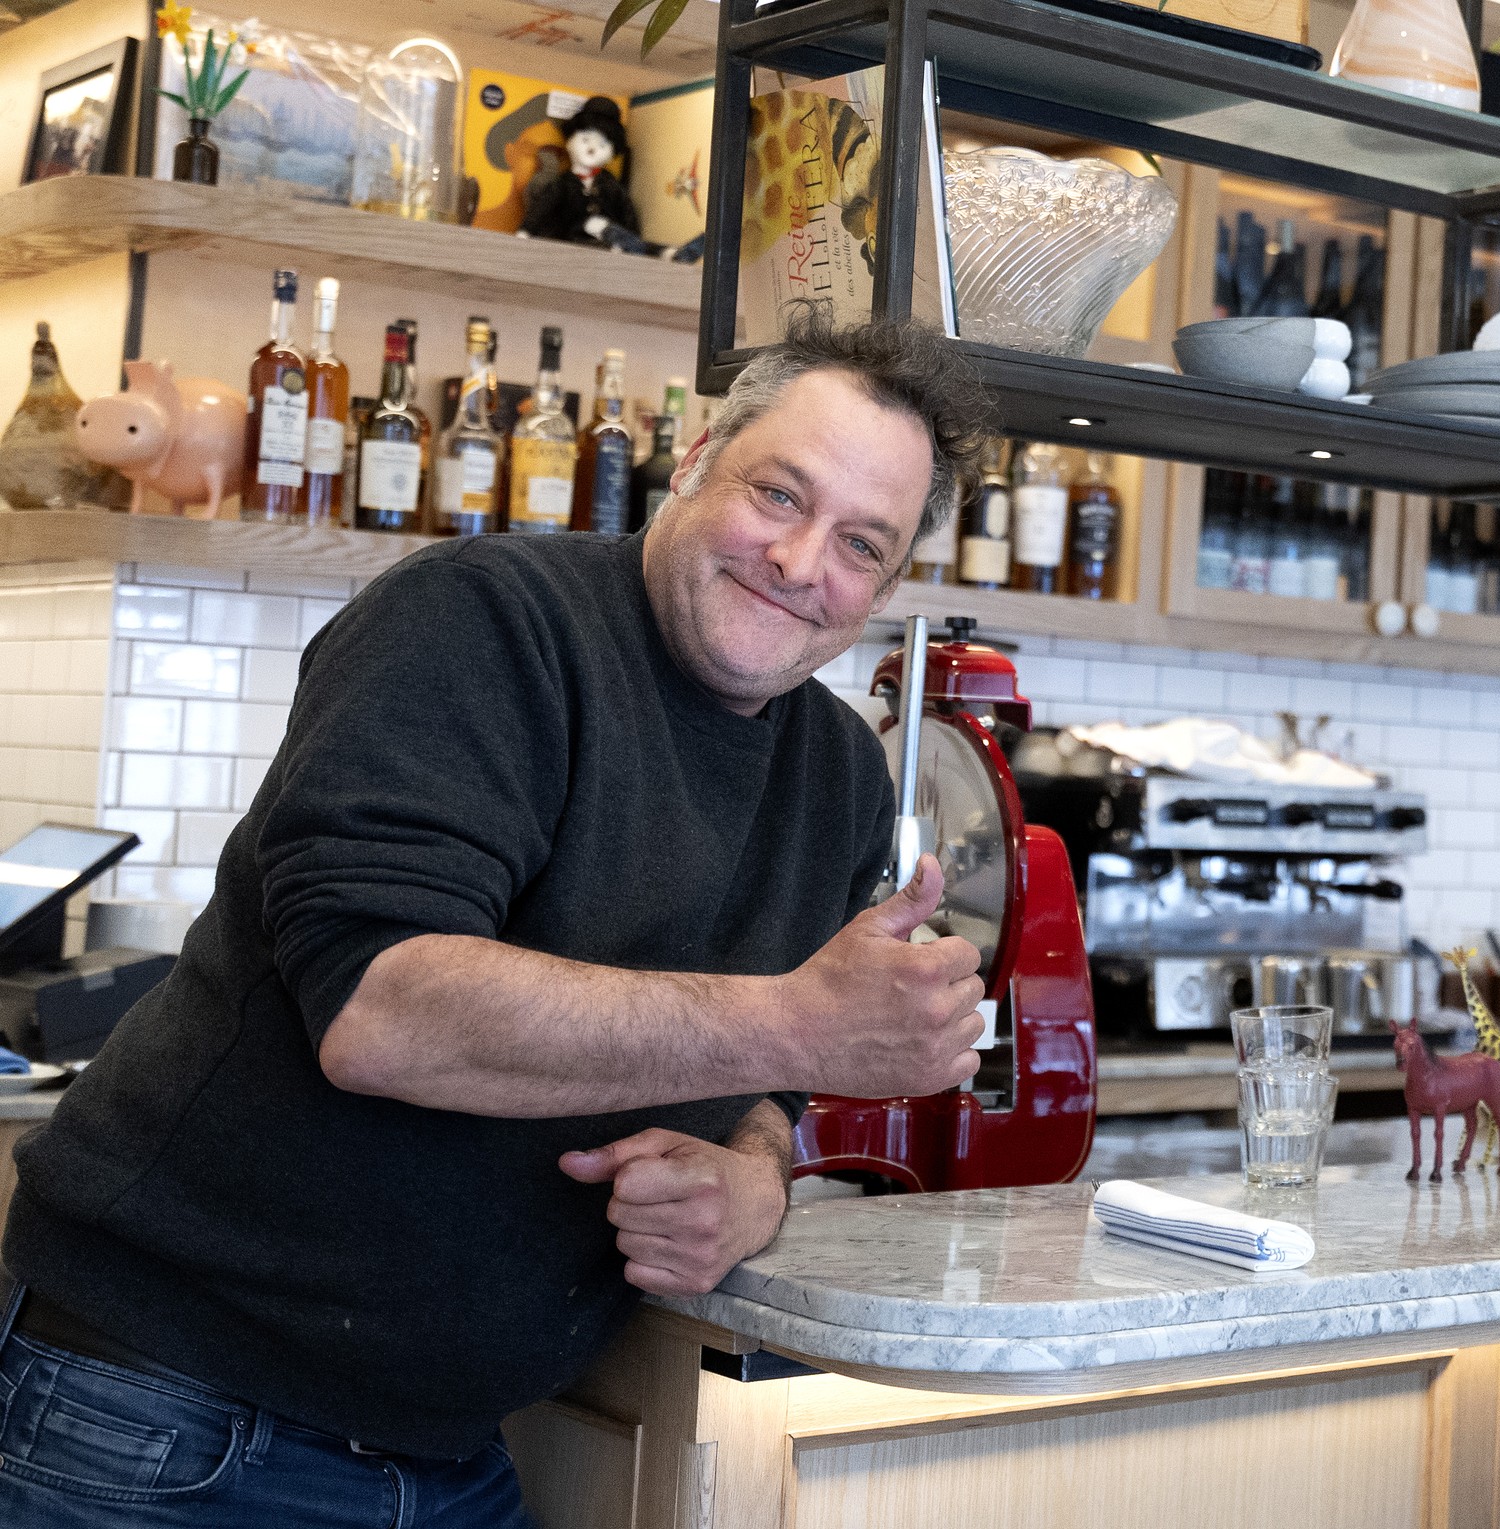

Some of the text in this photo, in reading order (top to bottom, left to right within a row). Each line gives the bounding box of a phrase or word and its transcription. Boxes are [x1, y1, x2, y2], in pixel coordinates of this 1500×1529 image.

[788, 196, 815, 299] Reine
[831, 226, 842, 271] et la vie
[843, 234, 855, 297] des abeilles
